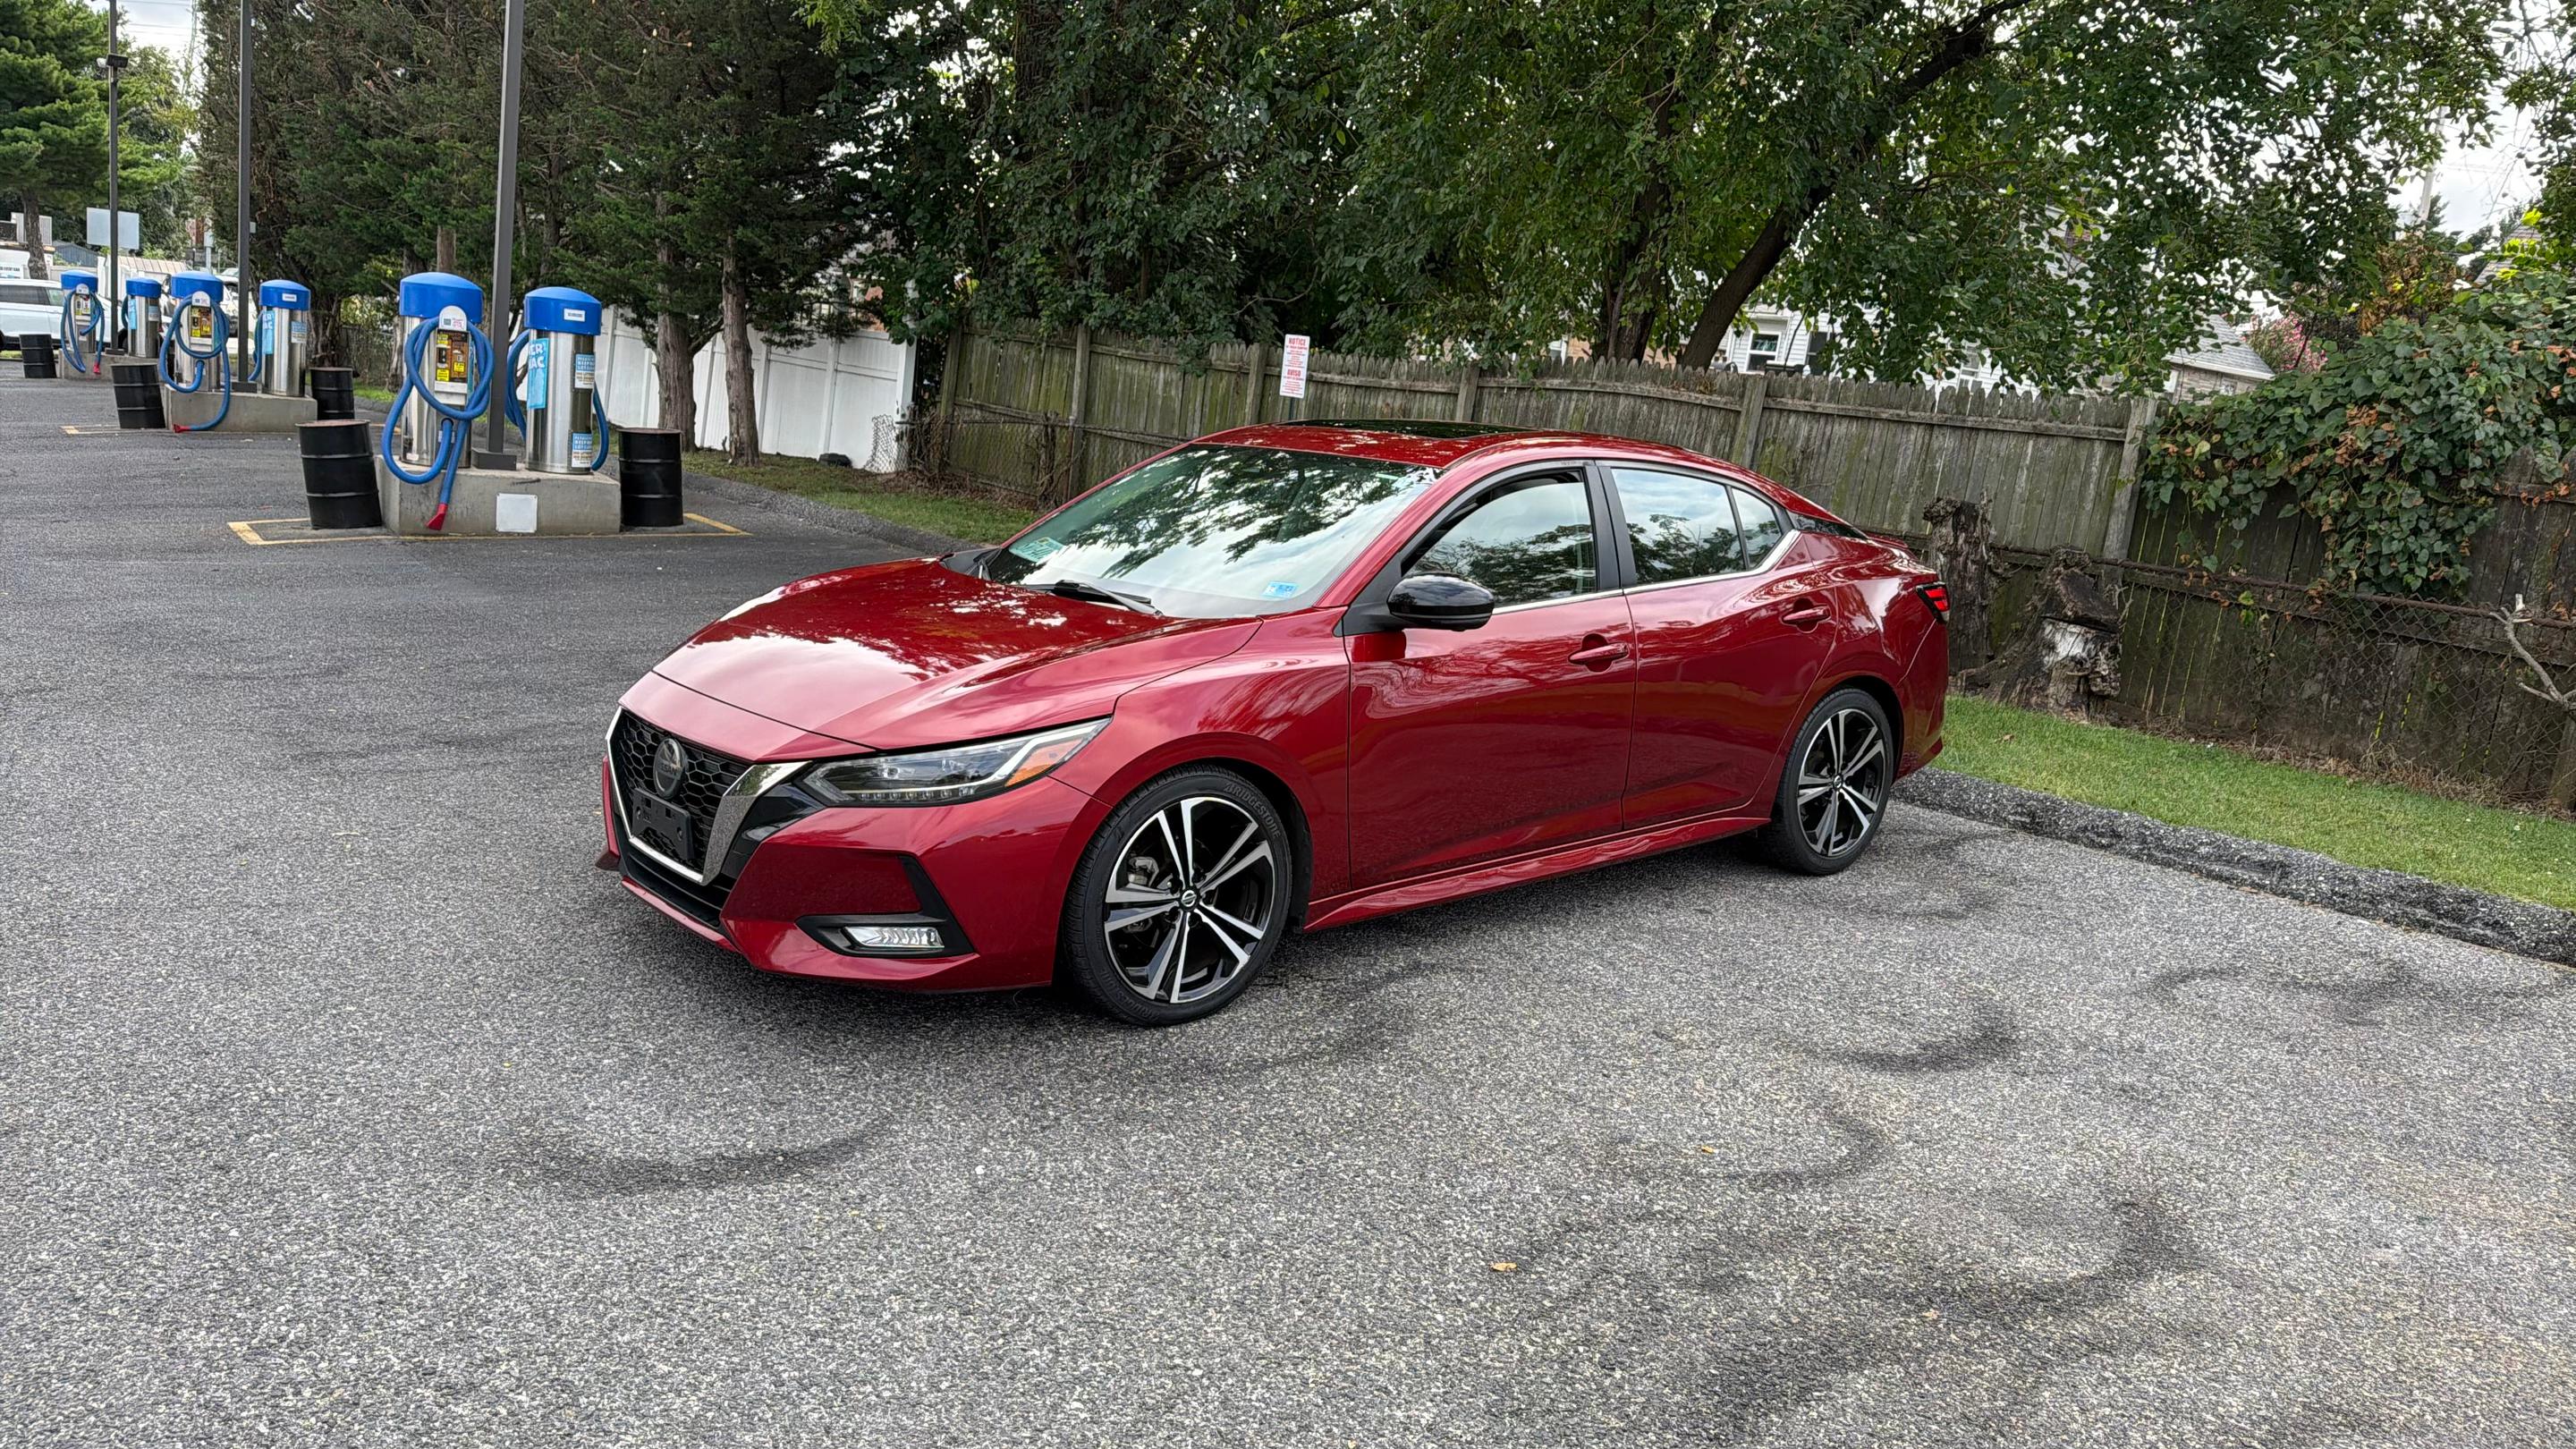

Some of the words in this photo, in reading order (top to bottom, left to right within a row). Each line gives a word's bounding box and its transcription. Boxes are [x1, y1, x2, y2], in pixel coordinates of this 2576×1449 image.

[1288, 337, 1306, 346] NOTICE
[529, 342, 540, 352] ER
[1224, 783, 1281, 838] BRIDGESTONE
